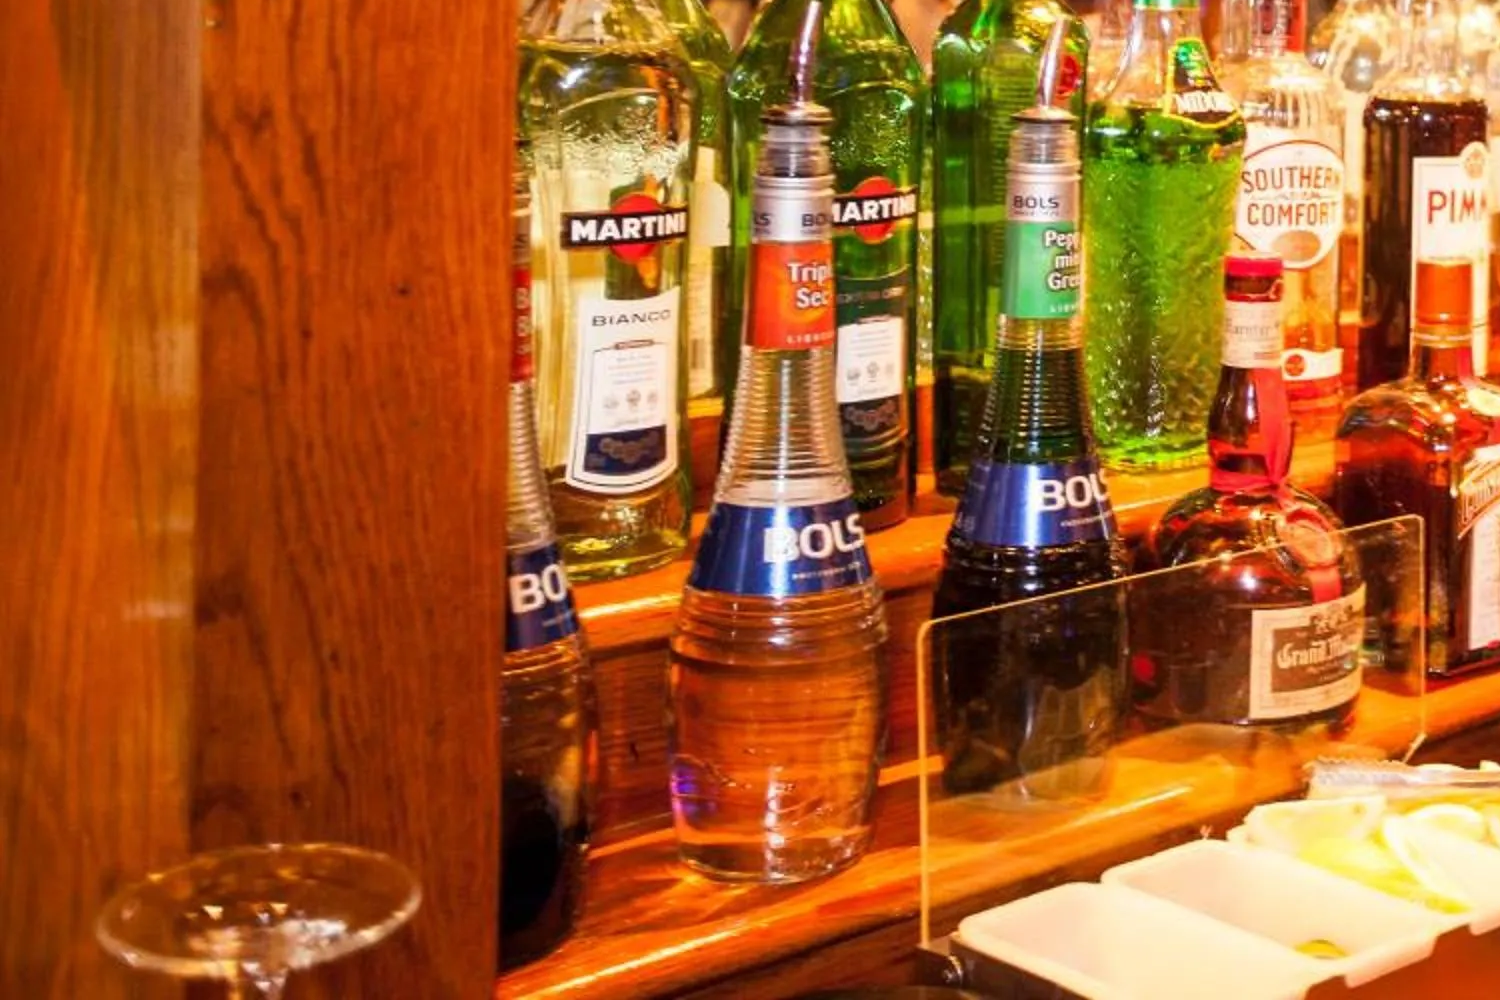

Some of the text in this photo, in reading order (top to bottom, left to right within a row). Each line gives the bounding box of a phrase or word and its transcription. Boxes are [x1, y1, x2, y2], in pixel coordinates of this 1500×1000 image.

[1013, 195, 1059, 209] BOLS
[1247, 201, 1338, 227] COMFORT
[571, 212, 686, 243] MARTINI
[592, 309, 671, 327] BIANCO
[763, 512, 865, 564] BOLS
[509, 561, 568, 615] BO
